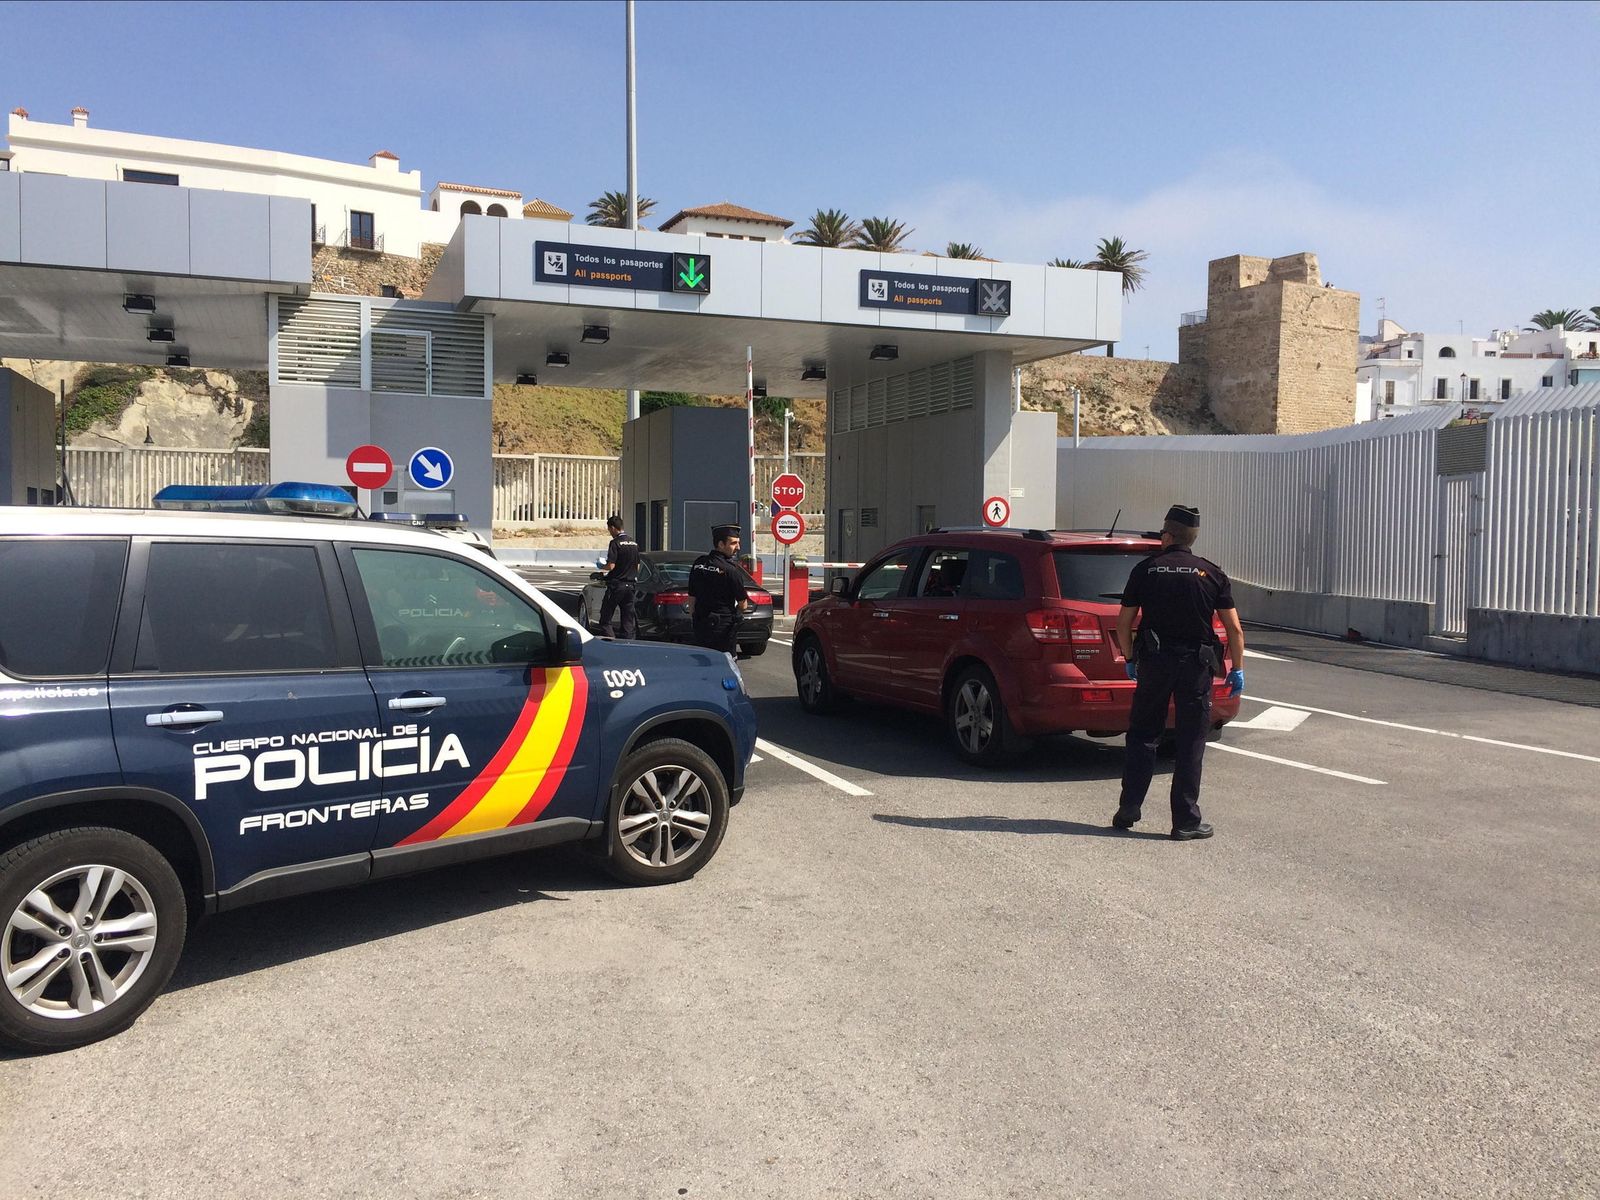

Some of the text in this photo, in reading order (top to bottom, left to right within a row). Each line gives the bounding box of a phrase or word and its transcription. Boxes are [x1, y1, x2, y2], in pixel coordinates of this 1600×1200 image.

[574, 253, 664, 269] Todos los pasaportes
[574, 269, 632, 282] All passports
[893, 280, 970, 294] Todos los pasaportes
[893, 295, 943, 306] All passports
[774, 486, 803, 495] STOP
[694, 564, 720, 574] POLICIA
[1147, 566, 1200, 575] POLICIA
[399, 608, 464, 617] POLICIA
[192, 724, 418, 755] CUERPO NACIONAL DE
[194, 726, 471, 800] POLICÍA
[239, 793, 429, 835] FRONTERAS
